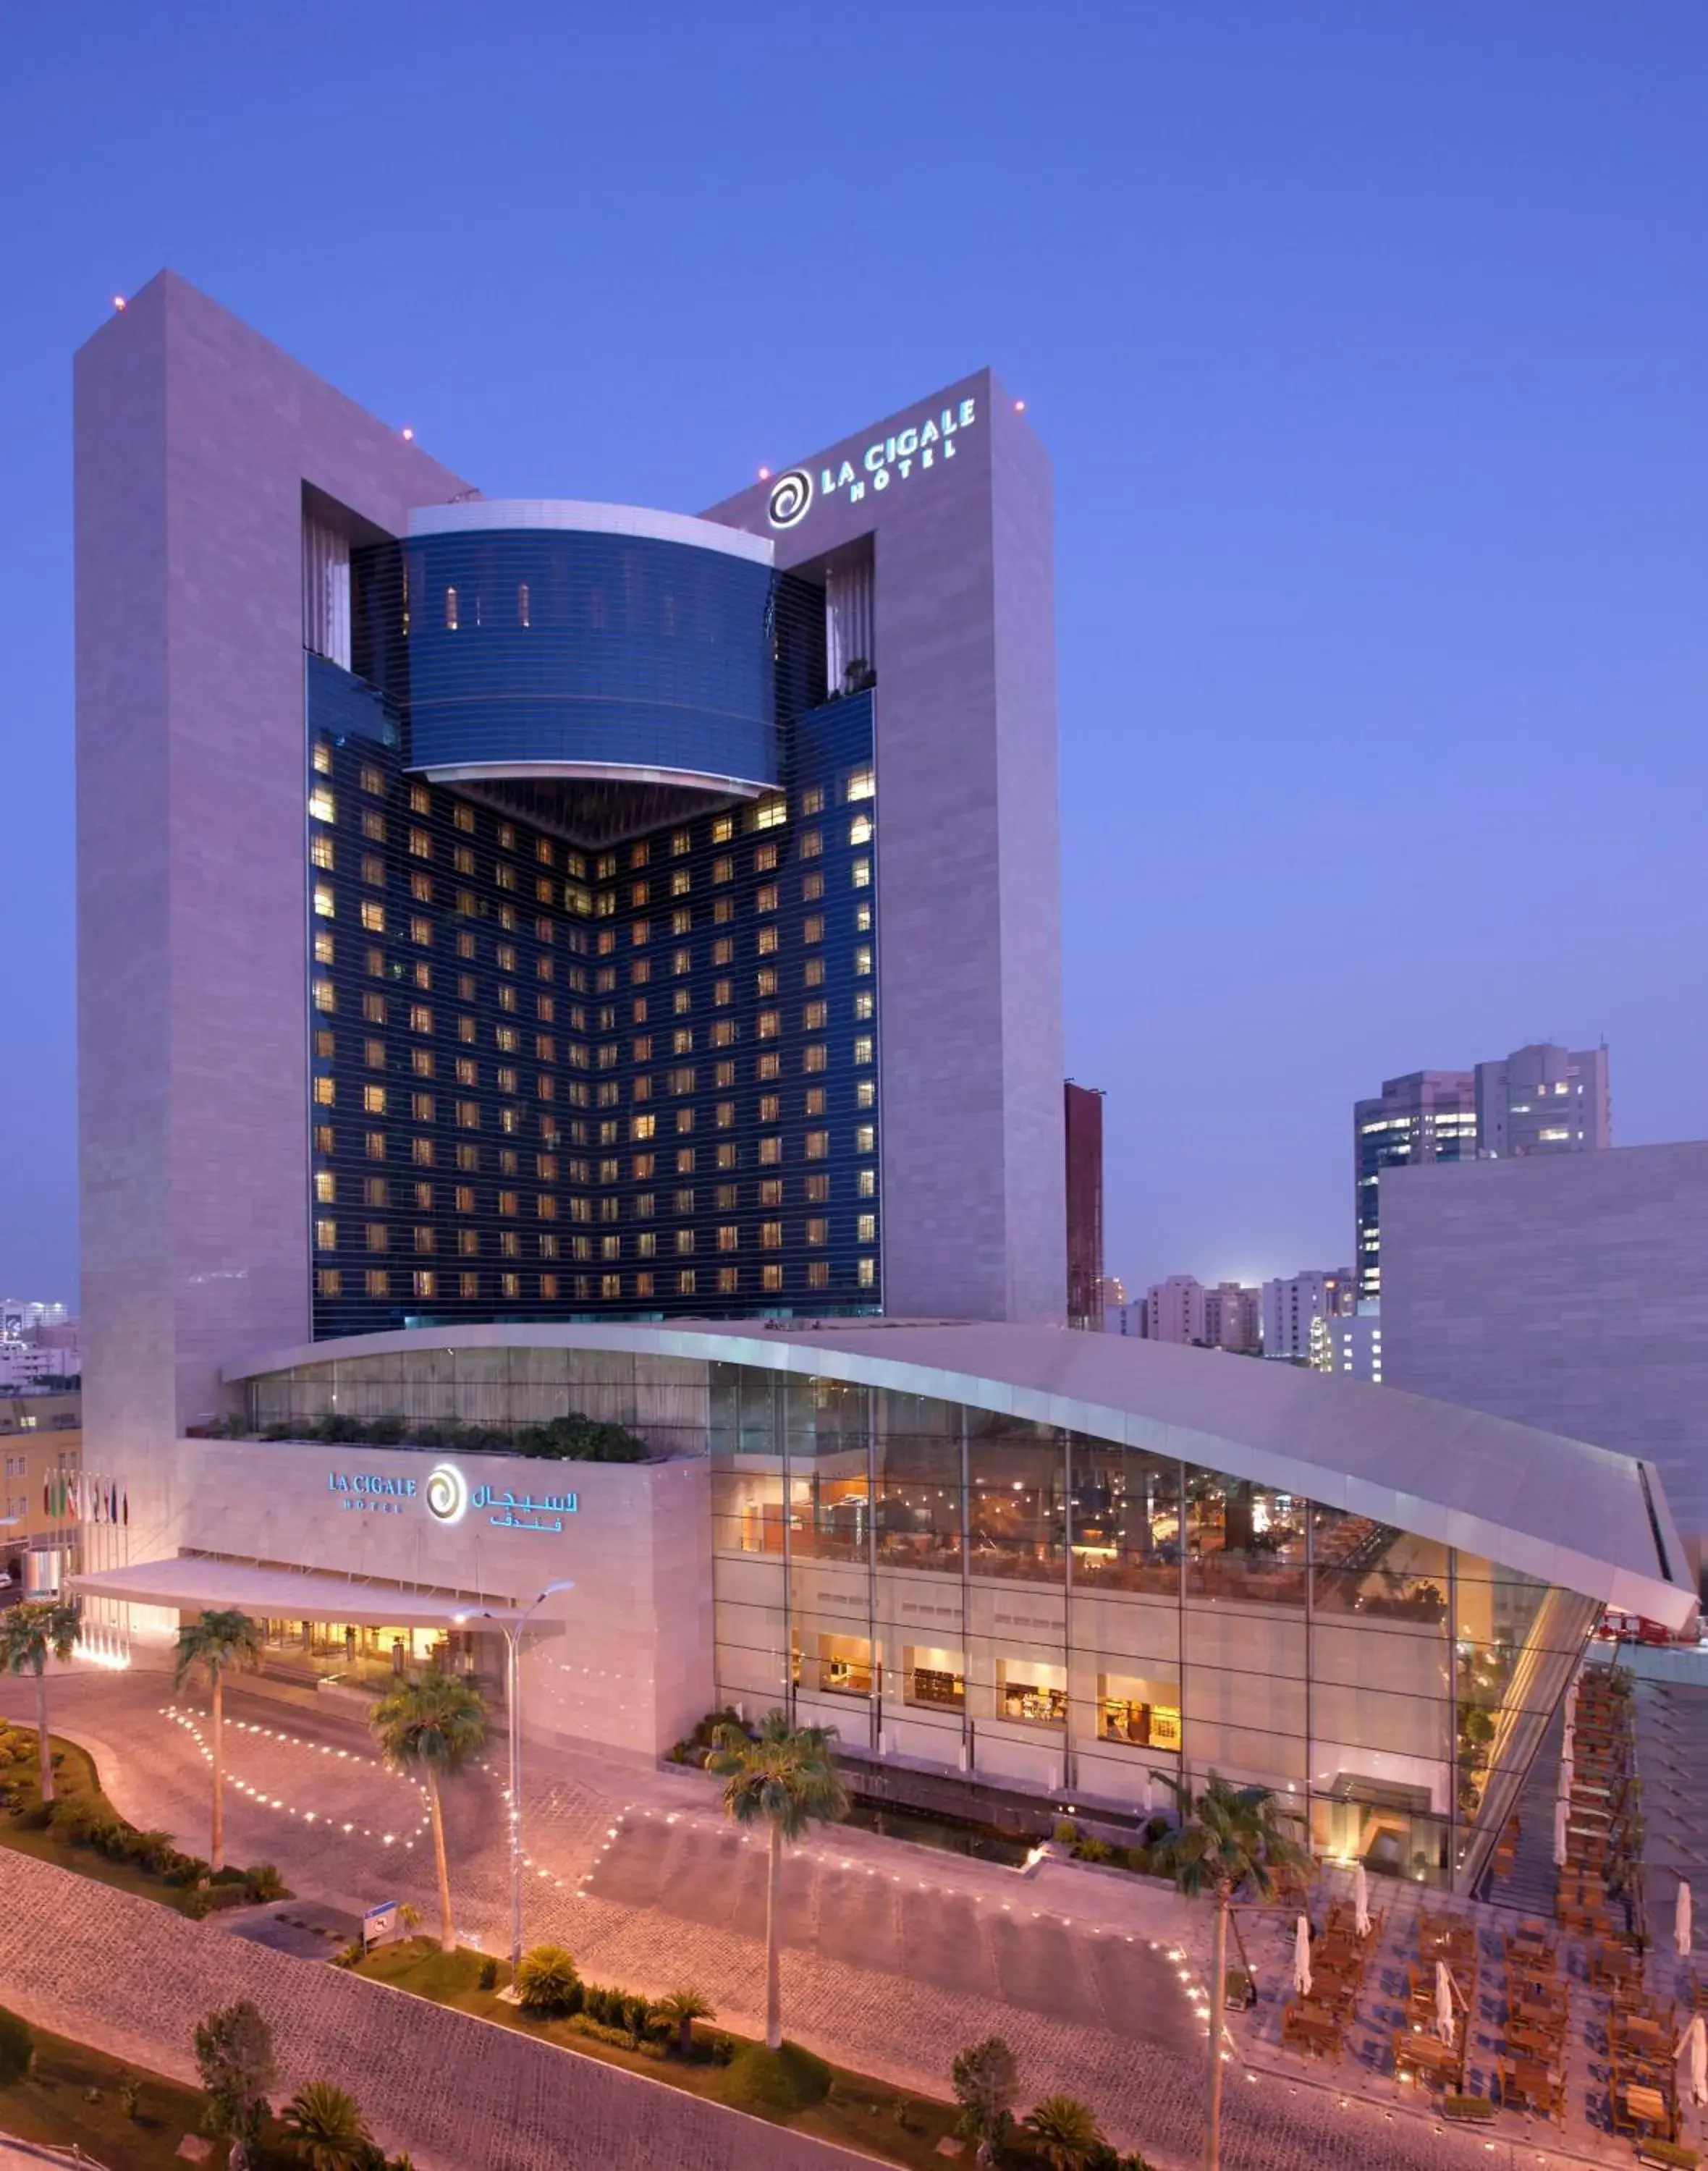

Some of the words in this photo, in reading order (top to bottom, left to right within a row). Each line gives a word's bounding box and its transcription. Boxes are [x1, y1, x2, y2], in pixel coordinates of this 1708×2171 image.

[821, 460, 855, 495] LA
[864, 398, 976, 471] CIGALE
[850, 439, 956, 503] HOTEL
[329, 1472, 350, 1491] LA
[353, 1476, 417, 1497] CIGALE
[489, 1512, 562, 1533] فندق
